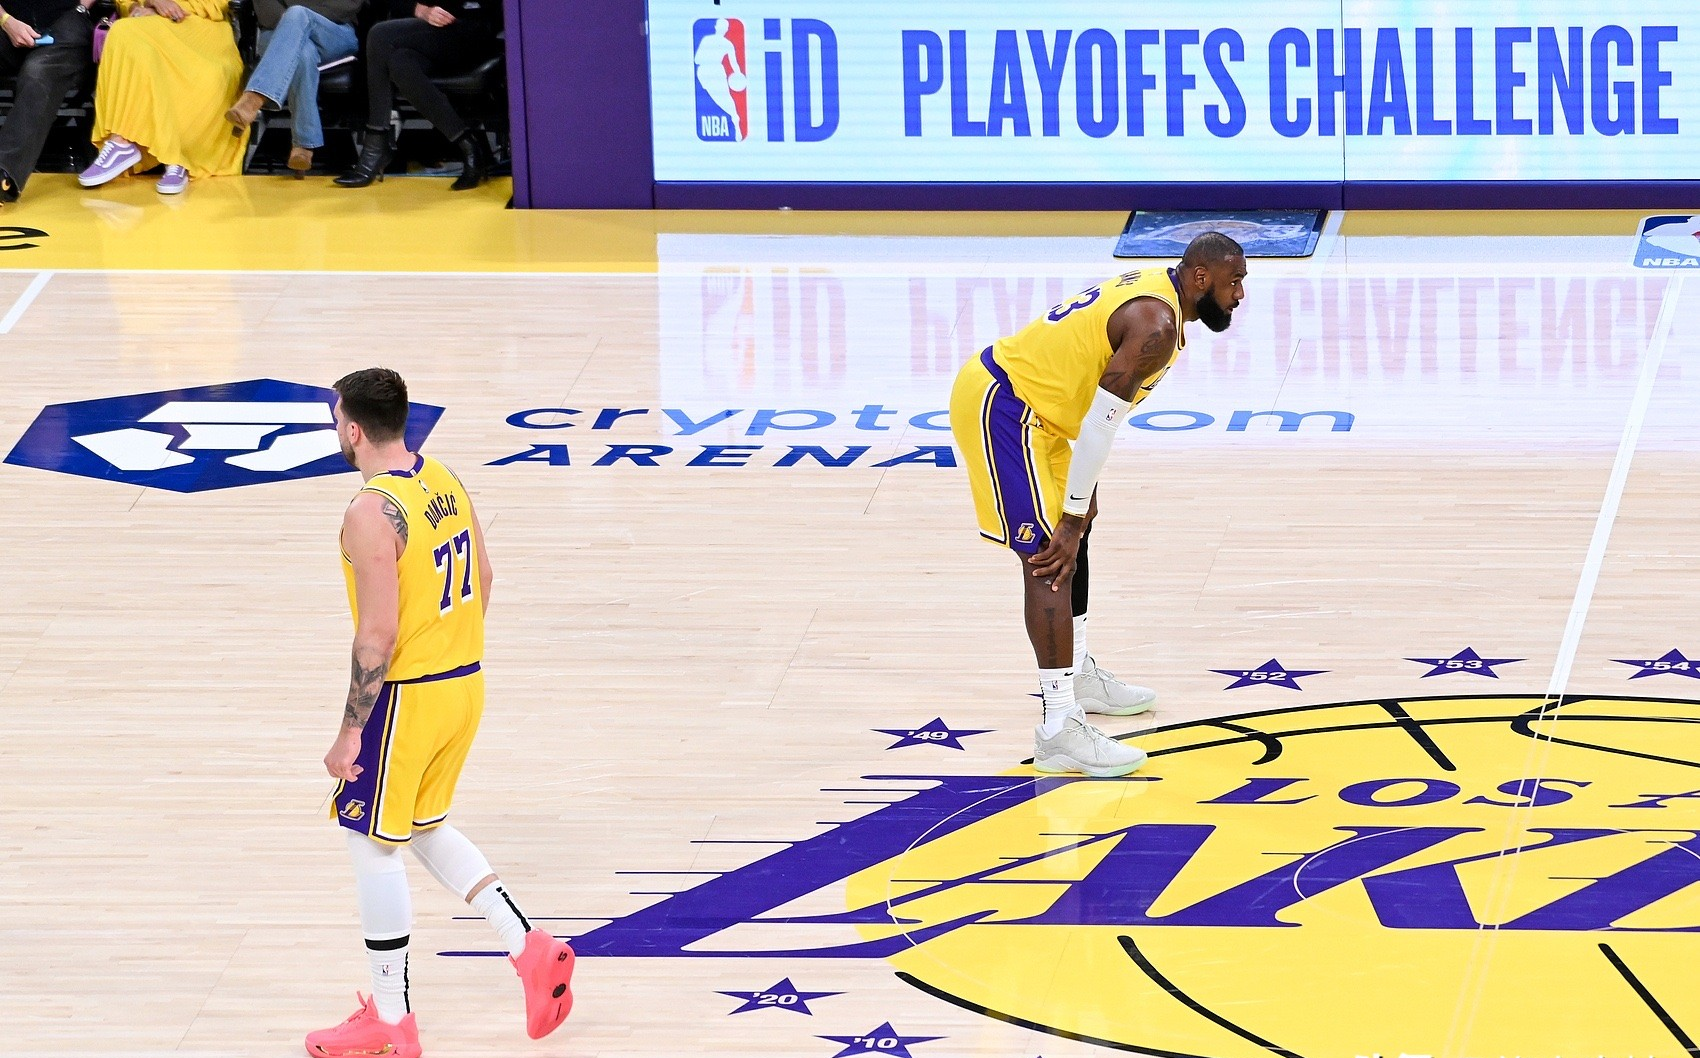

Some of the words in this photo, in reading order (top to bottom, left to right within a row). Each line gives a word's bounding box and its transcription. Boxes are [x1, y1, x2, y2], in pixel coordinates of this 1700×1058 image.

[763, 18, 840, 142] iD
[901, 27, 1247, 139] PLAYOFFS
[1268, 24, 1680, 138] CHALLENGE
[701, 115, 730, 137] NBA
[1642, 257, 1699, 267] NBA
[482, 443, 959, 467] ARENA
[423, 491, 459, 531] DONČIĆ
[431, 526, 475, 618] 77
[1196, 777, 1593, 808] LOS
